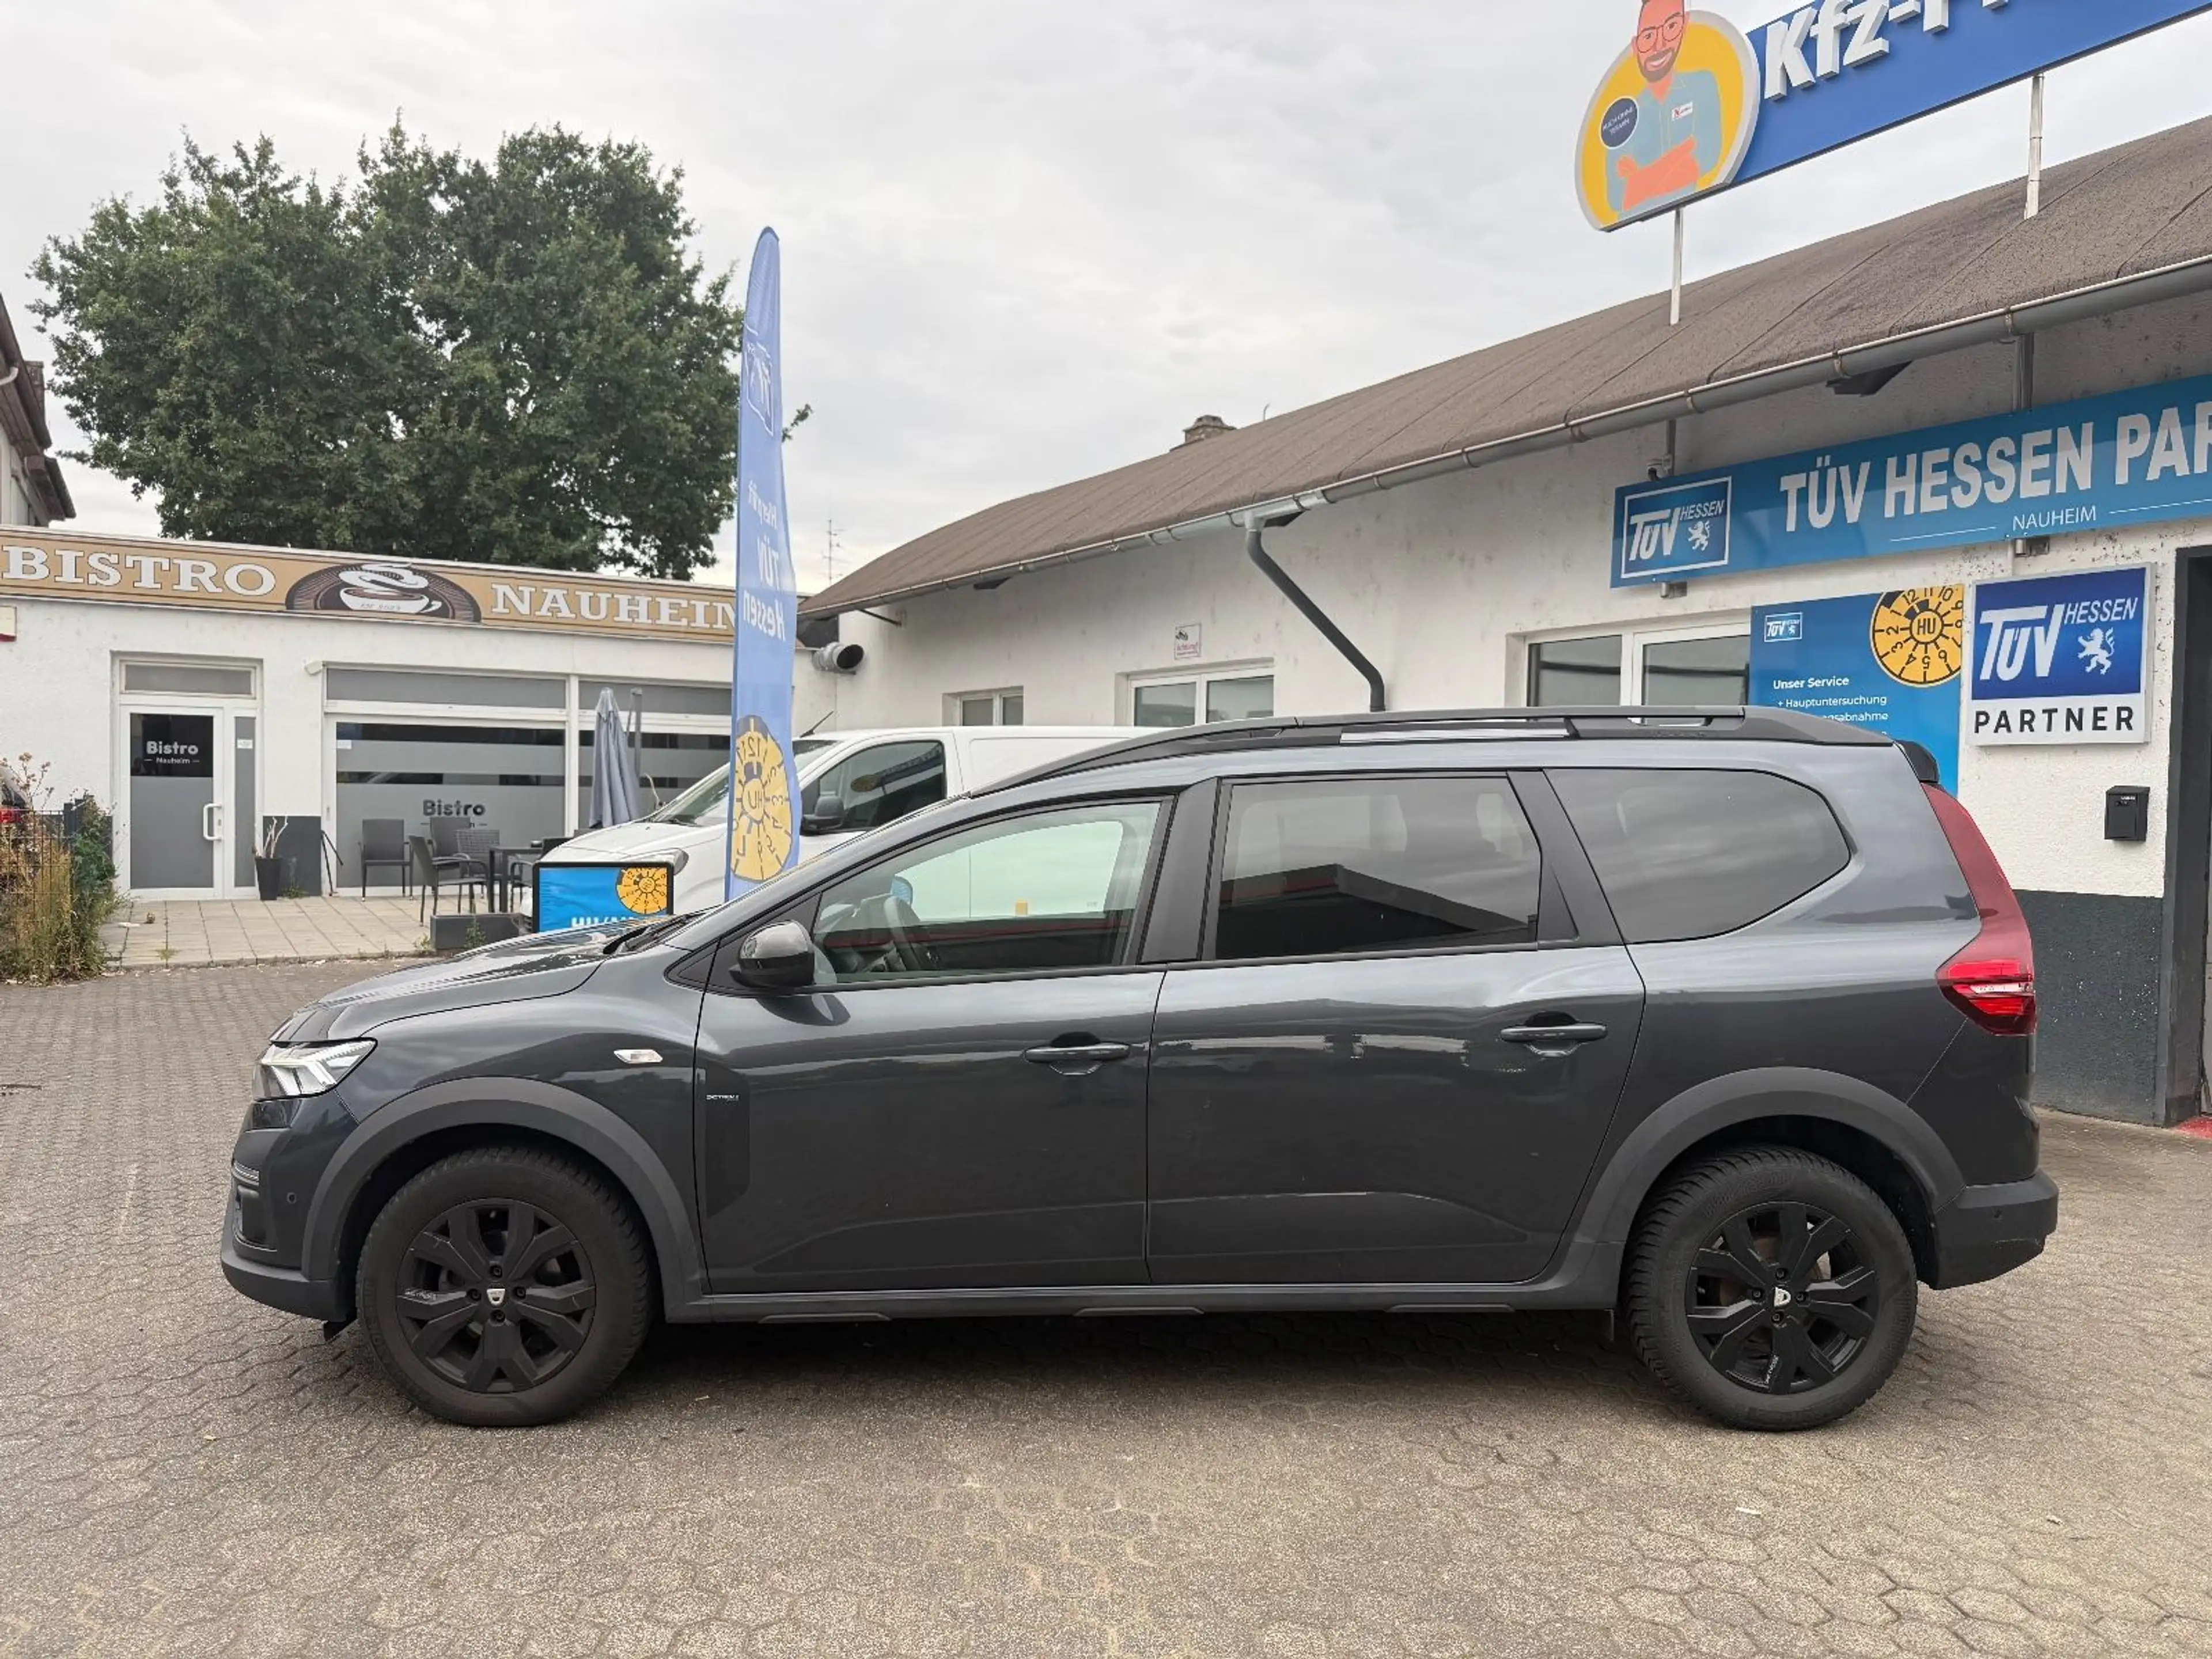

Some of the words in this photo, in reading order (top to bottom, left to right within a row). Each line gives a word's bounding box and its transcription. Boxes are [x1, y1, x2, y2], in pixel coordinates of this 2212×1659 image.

[1779, 455, 1870, 532] TÜV
[1884, 422, 2094, 518] HESSEN
[1680, 499, 1726, 521] HESSEN
[2012, 505, 2097, 532] NAUHEIM
[1, 544, 276, 597] BISTRO
[1917, 618, 1936, 635] HU
[1979, 603, 2065, 681] TÜV
[2064, 597, 2138, 625] HESSEN
[1773, 680, 1804, 690] Unser
[1808, 676, 1850, 688] Service
[1786, 695, 1887, 709] Hauptuntersuchung
[1974, 706, 2134, 734] PARTNER
[146, 741, 199, 755] Bistro
[423, 799, 486, 816] Bistro
